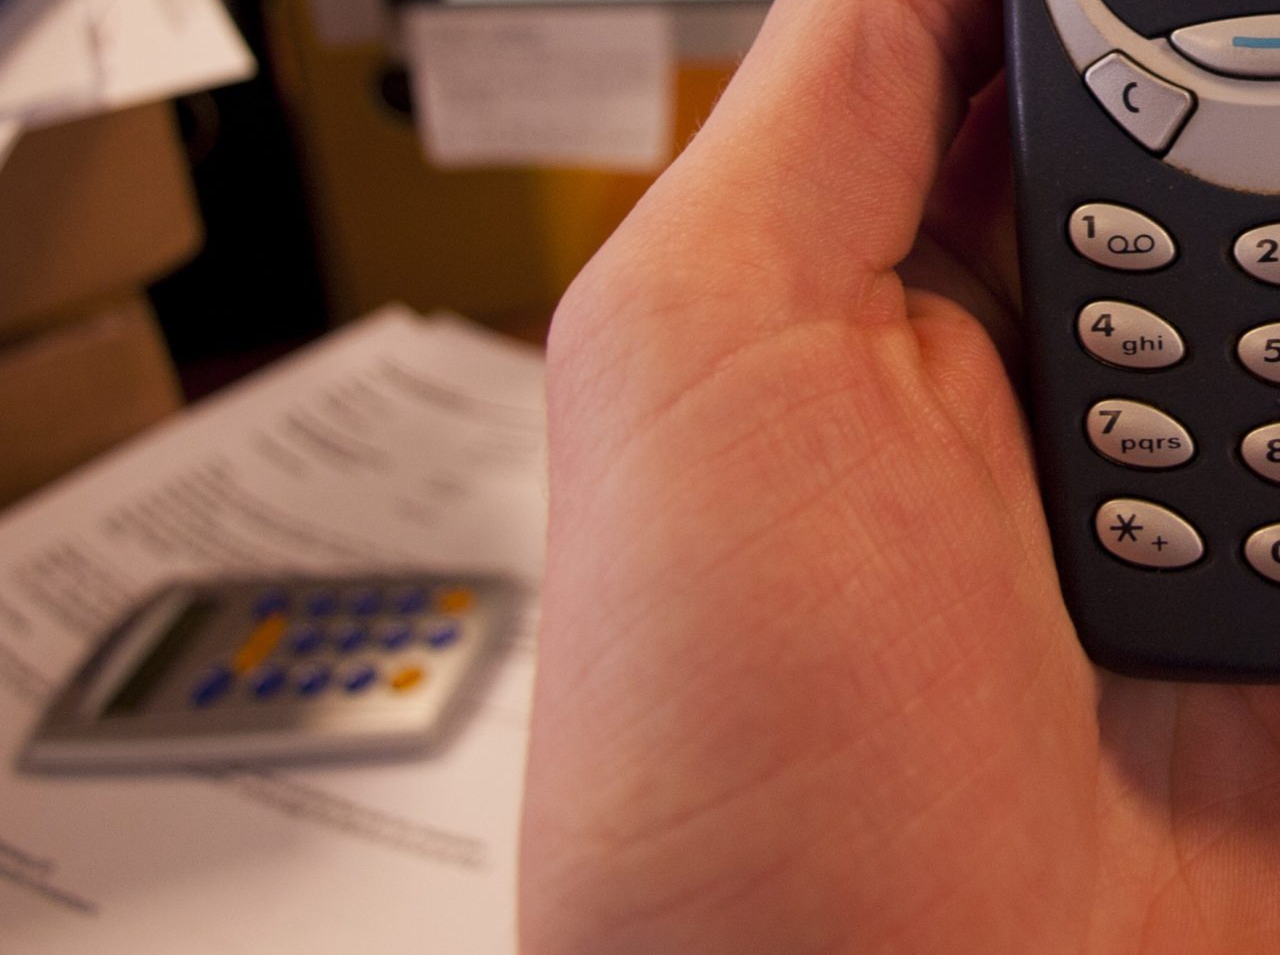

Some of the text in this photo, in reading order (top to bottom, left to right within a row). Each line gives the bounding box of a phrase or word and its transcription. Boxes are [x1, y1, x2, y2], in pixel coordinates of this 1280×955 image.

[1082, 215, 1096, 239] 1
[1256, 238, 1280, 264] 2
[1090, 313, 1163, 357] 4 ghi
[1098, 410, 1182, 455] 7 pqrs
